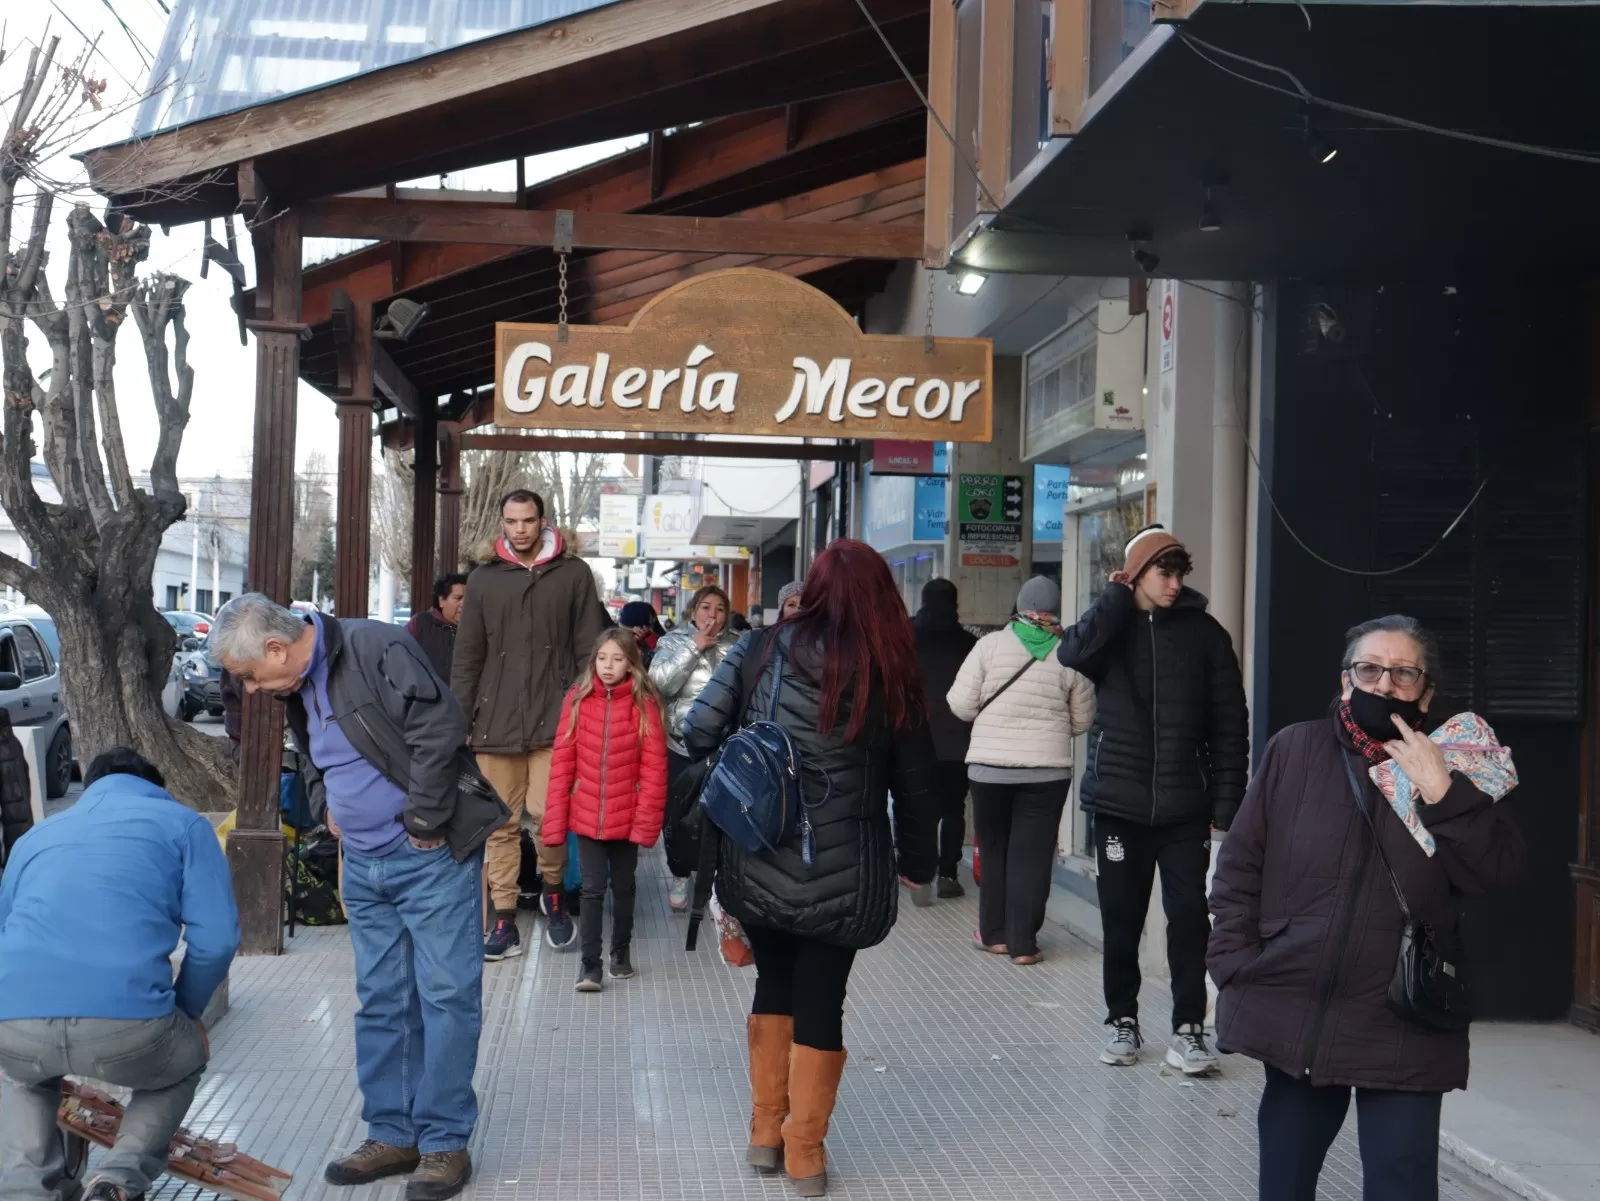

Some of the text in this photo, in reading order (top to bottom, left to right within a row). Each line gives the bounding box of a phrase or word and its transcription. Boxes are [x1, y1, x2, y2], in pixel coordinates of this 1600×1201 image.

[502, 341, 981, 423] Galería Mecor
[887, 456, 912, 465] LOCAL
[965, 524, 1016, 533] FOTOCOPIAS
[967, 532, 1020, 541] IMPRESIONES
[969, 555, 996, 565] LOCAL
